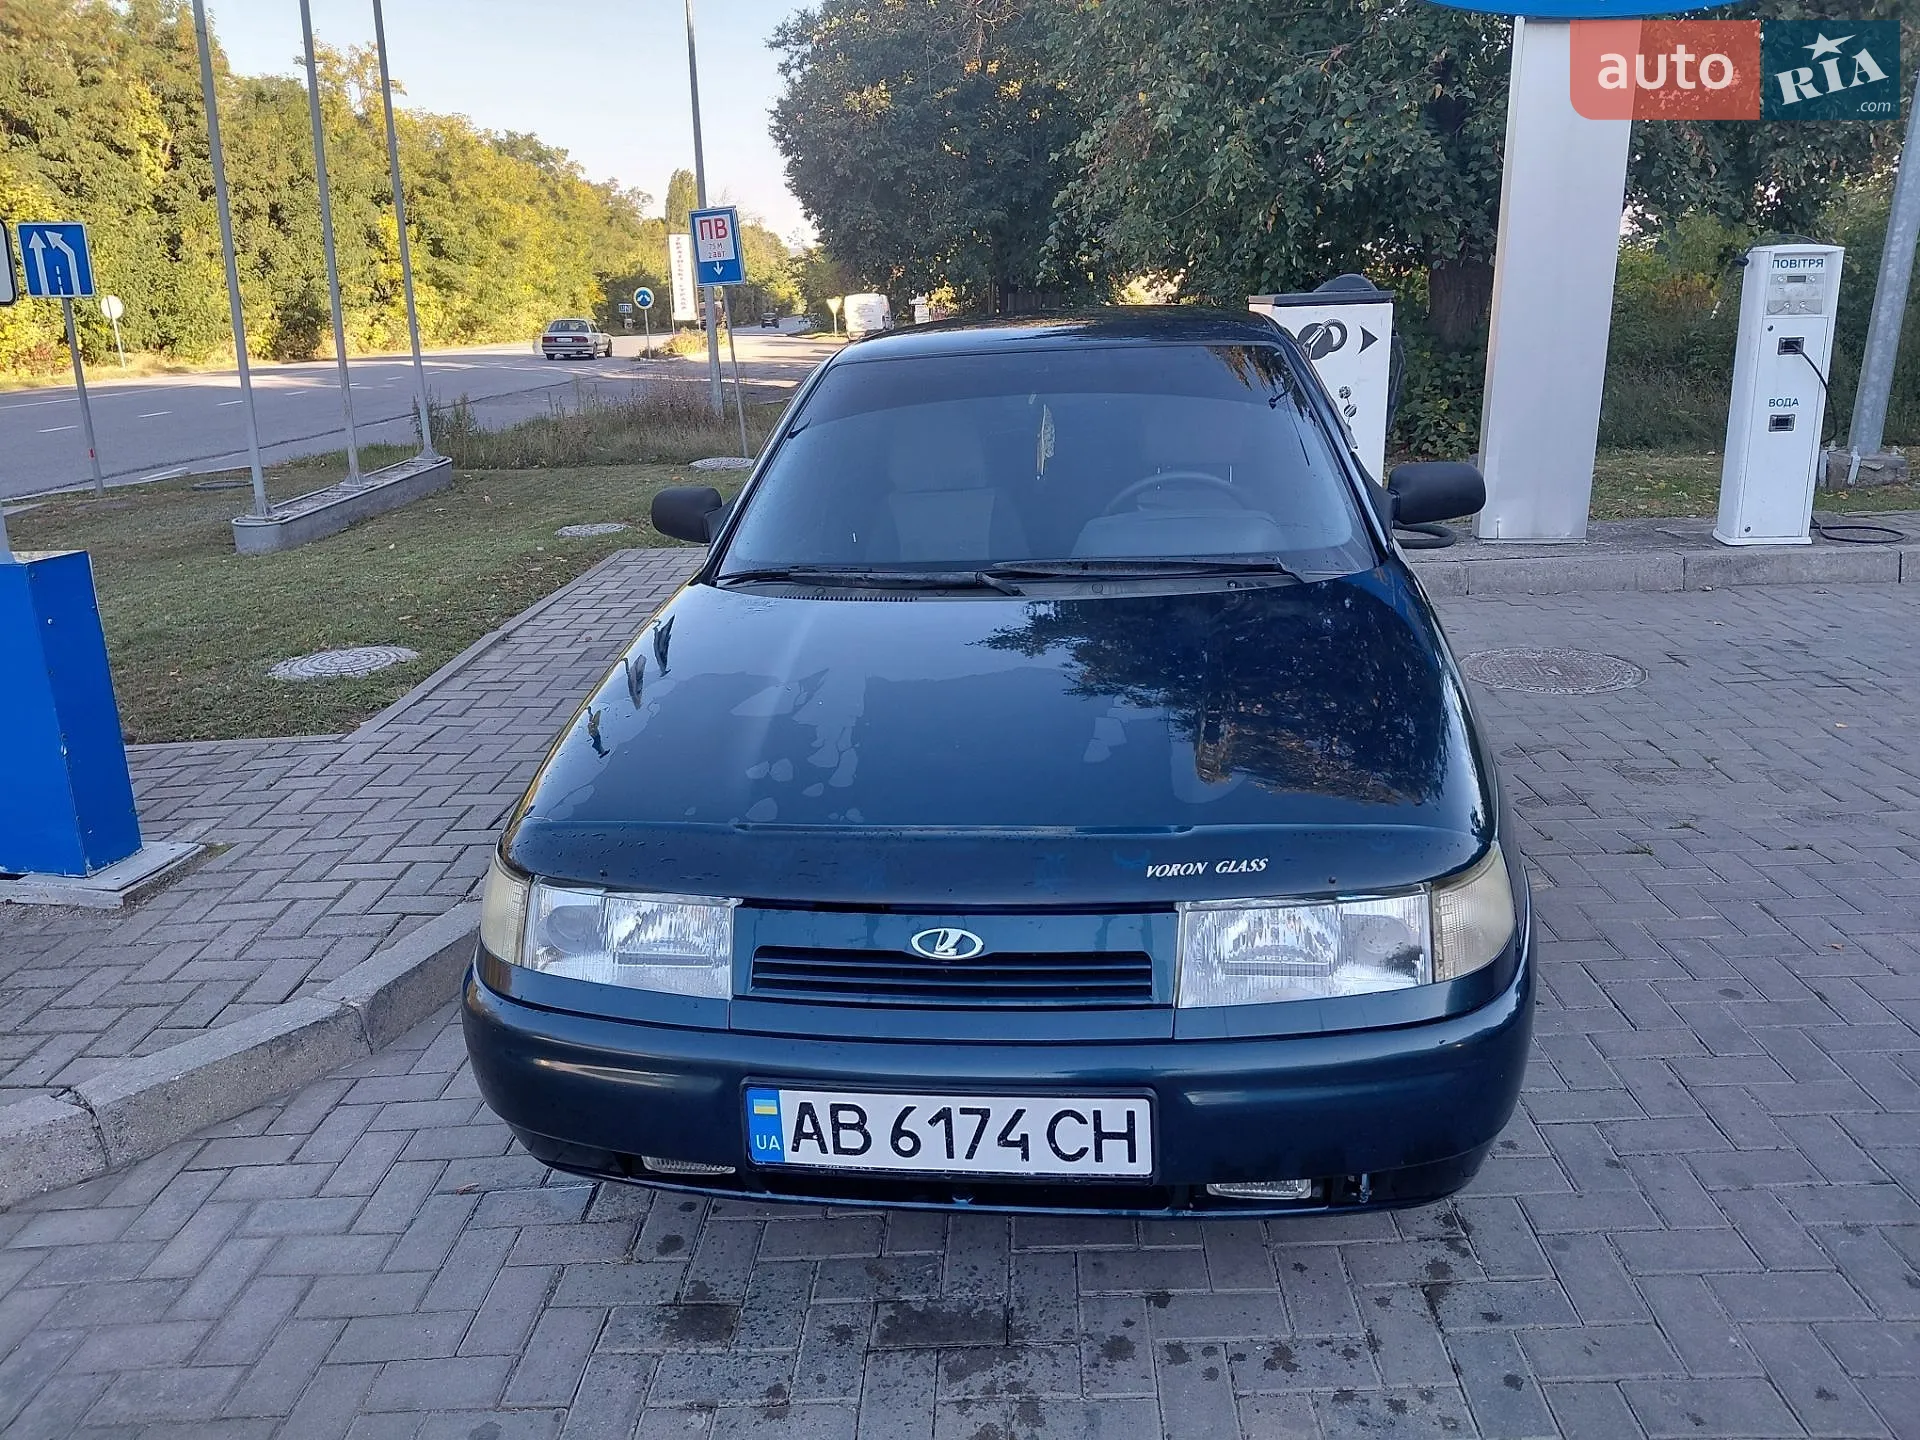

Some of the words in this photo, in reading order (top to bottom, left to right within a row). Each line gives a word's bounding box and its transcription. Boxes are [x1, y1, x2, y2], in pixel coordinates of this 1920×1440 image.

[699, 217, 728, 240] ПВ
[1771, 258, 1824, 269] ПОВІТРЯ
[1768, 397, 1800, 408] ВОДА
[1146, 861, 1209, 878] VORON
[1215, 857, 1269, 874] GLASS
[790, 1101, 873, 1157] AB
[889, 1105, 1031, 1162] 6174
[1046, 1108, 1136, 1164] CH
[755, 1134, 781, 1151] UA
